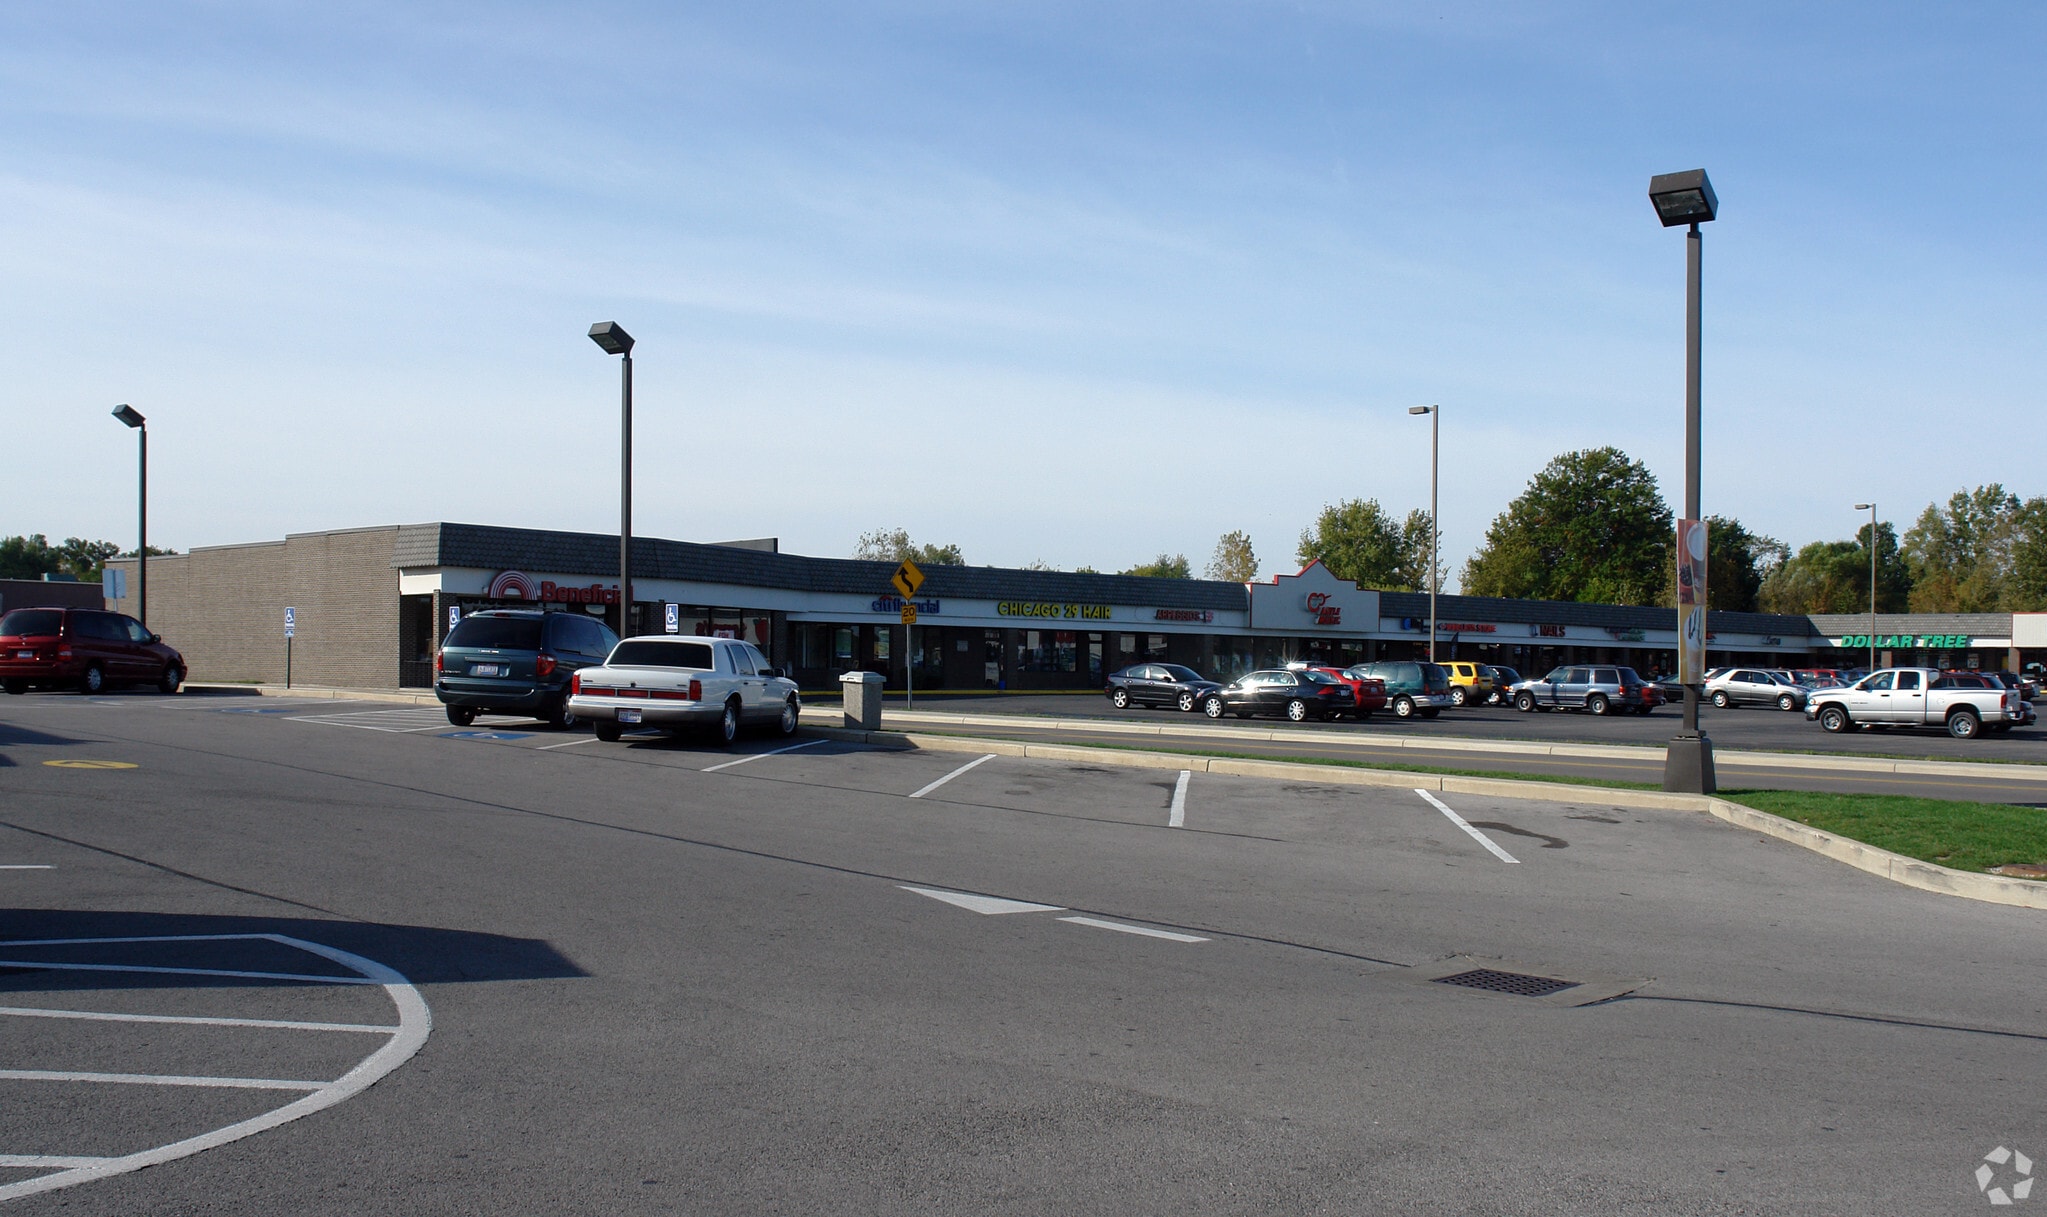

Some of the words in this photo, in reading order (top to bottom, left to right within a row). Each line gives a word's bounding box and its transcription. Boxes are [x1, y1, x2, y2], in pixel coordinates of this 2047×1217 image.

[903, 607, 915, 617] 20
[997, 602, 1061, 618] CHICAGO
[1063, 604, 1079, 618] 29
[1081, 605, 1112, 619] HAIR
[1540, 624, 1566, 637] NAILS
[1841, 635, 1914, 649] DOLLAR
[1921, 635, 1968, 649] TREE
